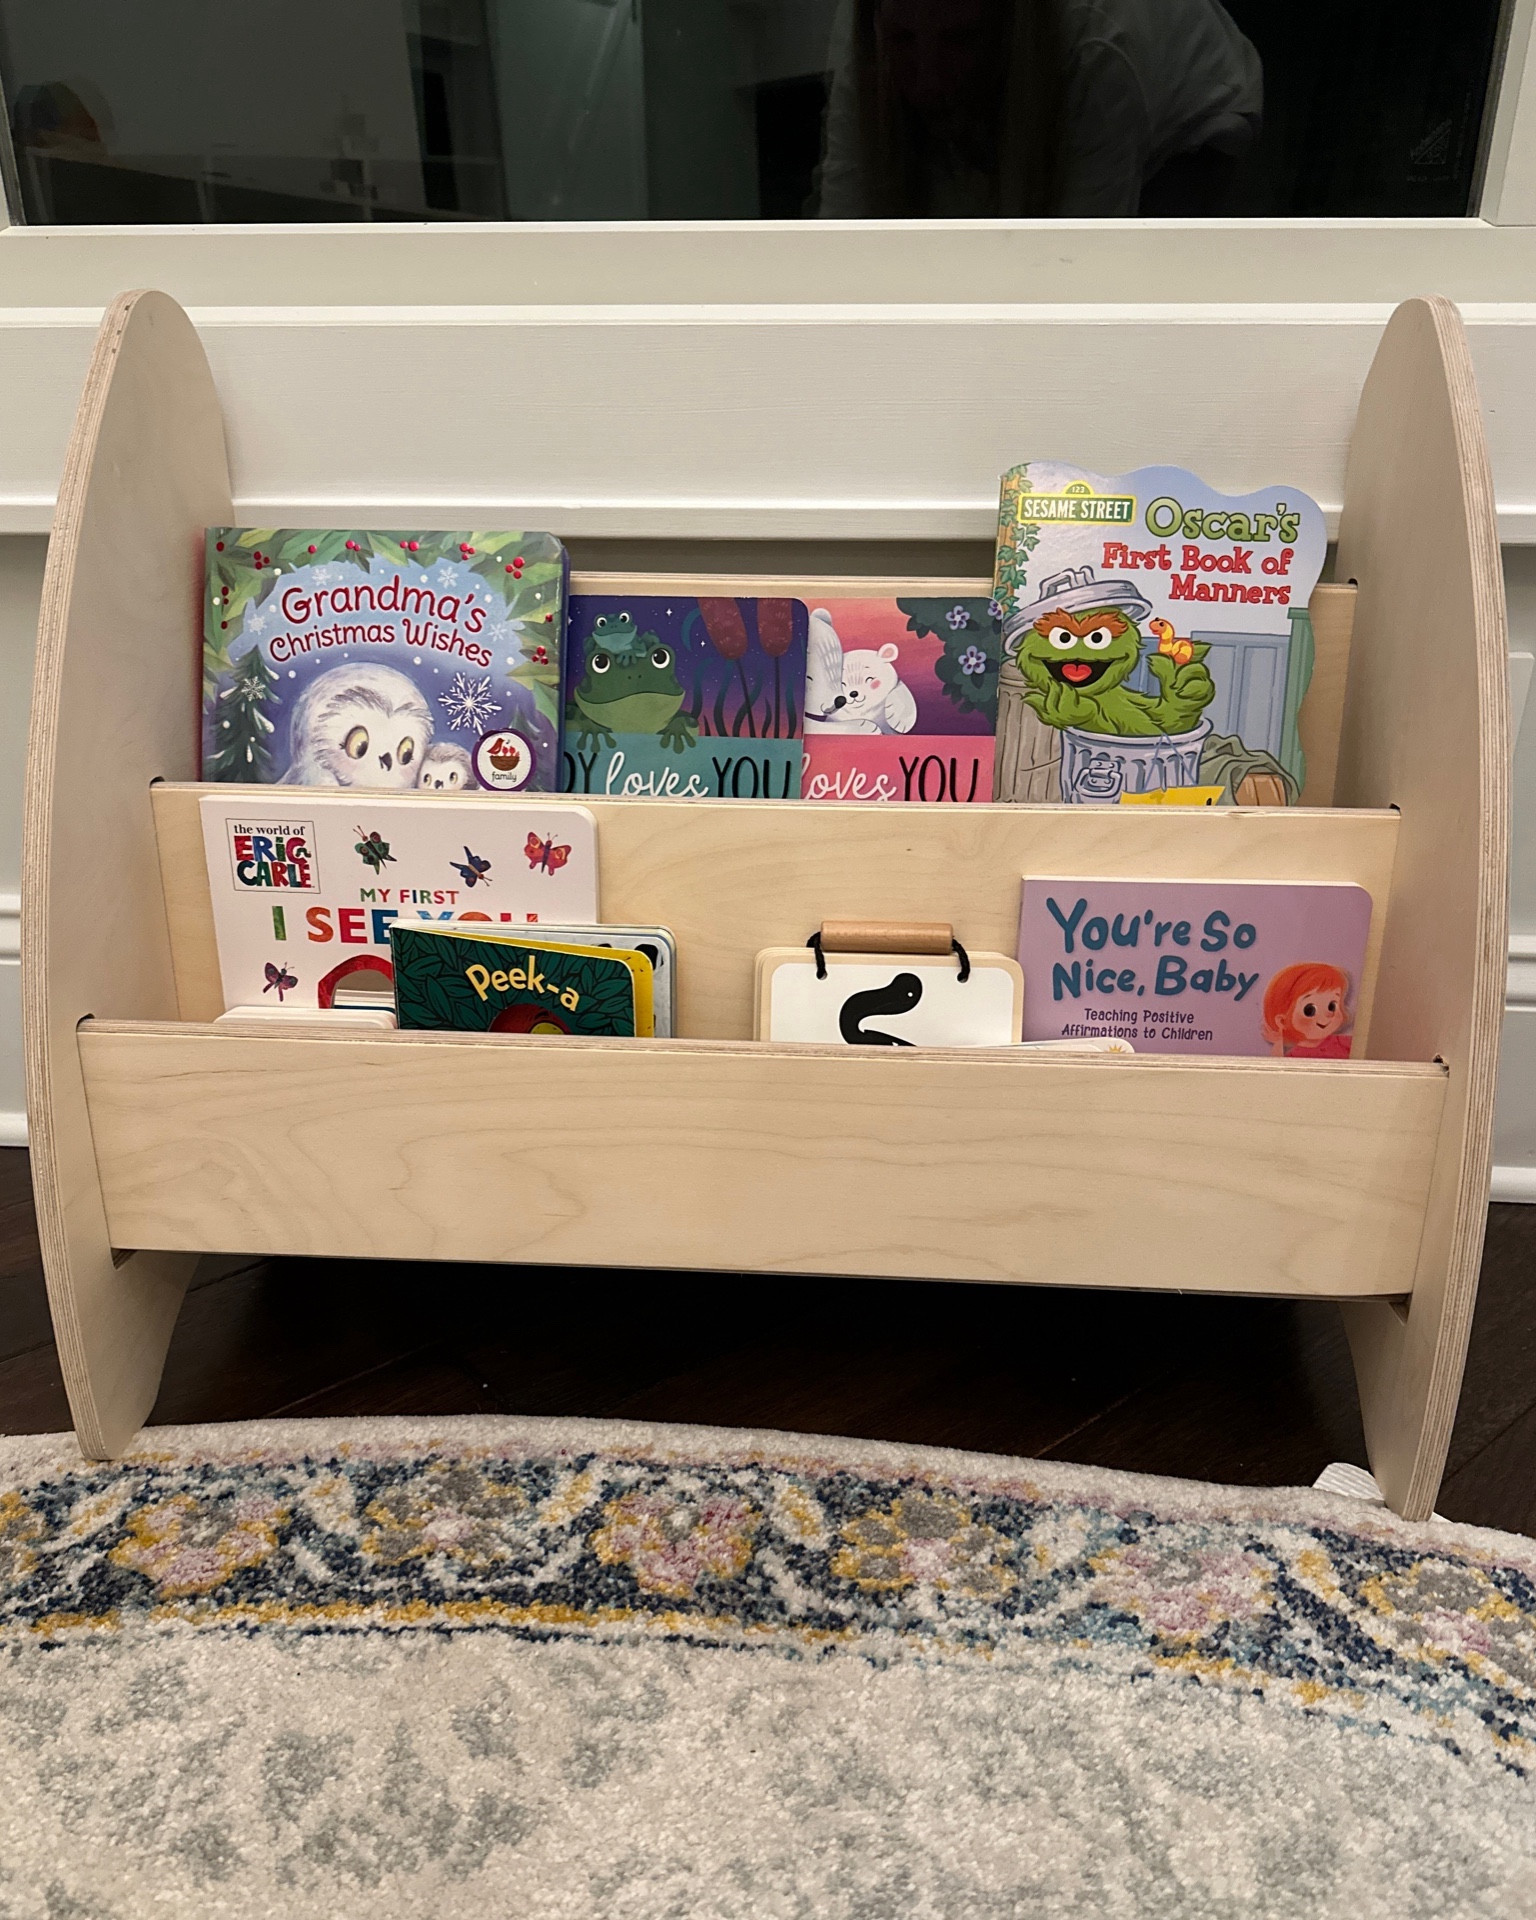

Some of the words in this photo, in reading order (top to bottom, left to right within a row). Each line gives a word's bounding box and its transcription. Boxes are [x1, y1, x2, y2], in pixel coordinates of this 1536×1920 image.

[1071, 485, 1085, 494] 123
[1023, 499, 1077, 518] SESAME
[1080, 501, 1131, 520] STREET
[1145, 496, 1300, 543] Oscar's
[1101, 542, 1172, 571] First
[1180, 545, 1253, 574] Book
[1261, 548, 1294, 575] of
[281, 574, 487, 633] Grandma's
[1168, 573, 1291, 605] Manners
[269, 622, 395, 662] Christmas
[402, 618, 493, 668] Wishes
[491, 771, 517, 783] family
[606, 751, 709, 798] loves
[712, 756, 792, 799] YOU
[898, 755, 979, 802] YOU
[233, 823, 254, 834] the
[255, 825, 291, 836] world
[292, 826, 306, 836] of
[236, 860, 312, 888] CARLE
[360, 888, 391, 903] MY
[399, 889, 460, 905] FIRST
[271, 905, 286, 941] I
[306, 908, 397, 944] SEE
[1046, 897, 1192, 954] You're
[1200, 910, 1257, 952] So
[465, 955, 580, 1012] Peek-a
[1052, 958, 1145, 1001] Nice,
[1154, 955, 1260, 1001] Baby
[1061, 1023, 1138, 1038] Affirmations
[1143, 1026, 1156, 1038] to
[1161, 1026, 1213, 1041] Children
[1084, 1008, 1138, 1024] Teaching
[1143, 1010, 1195, 1024] Positive
